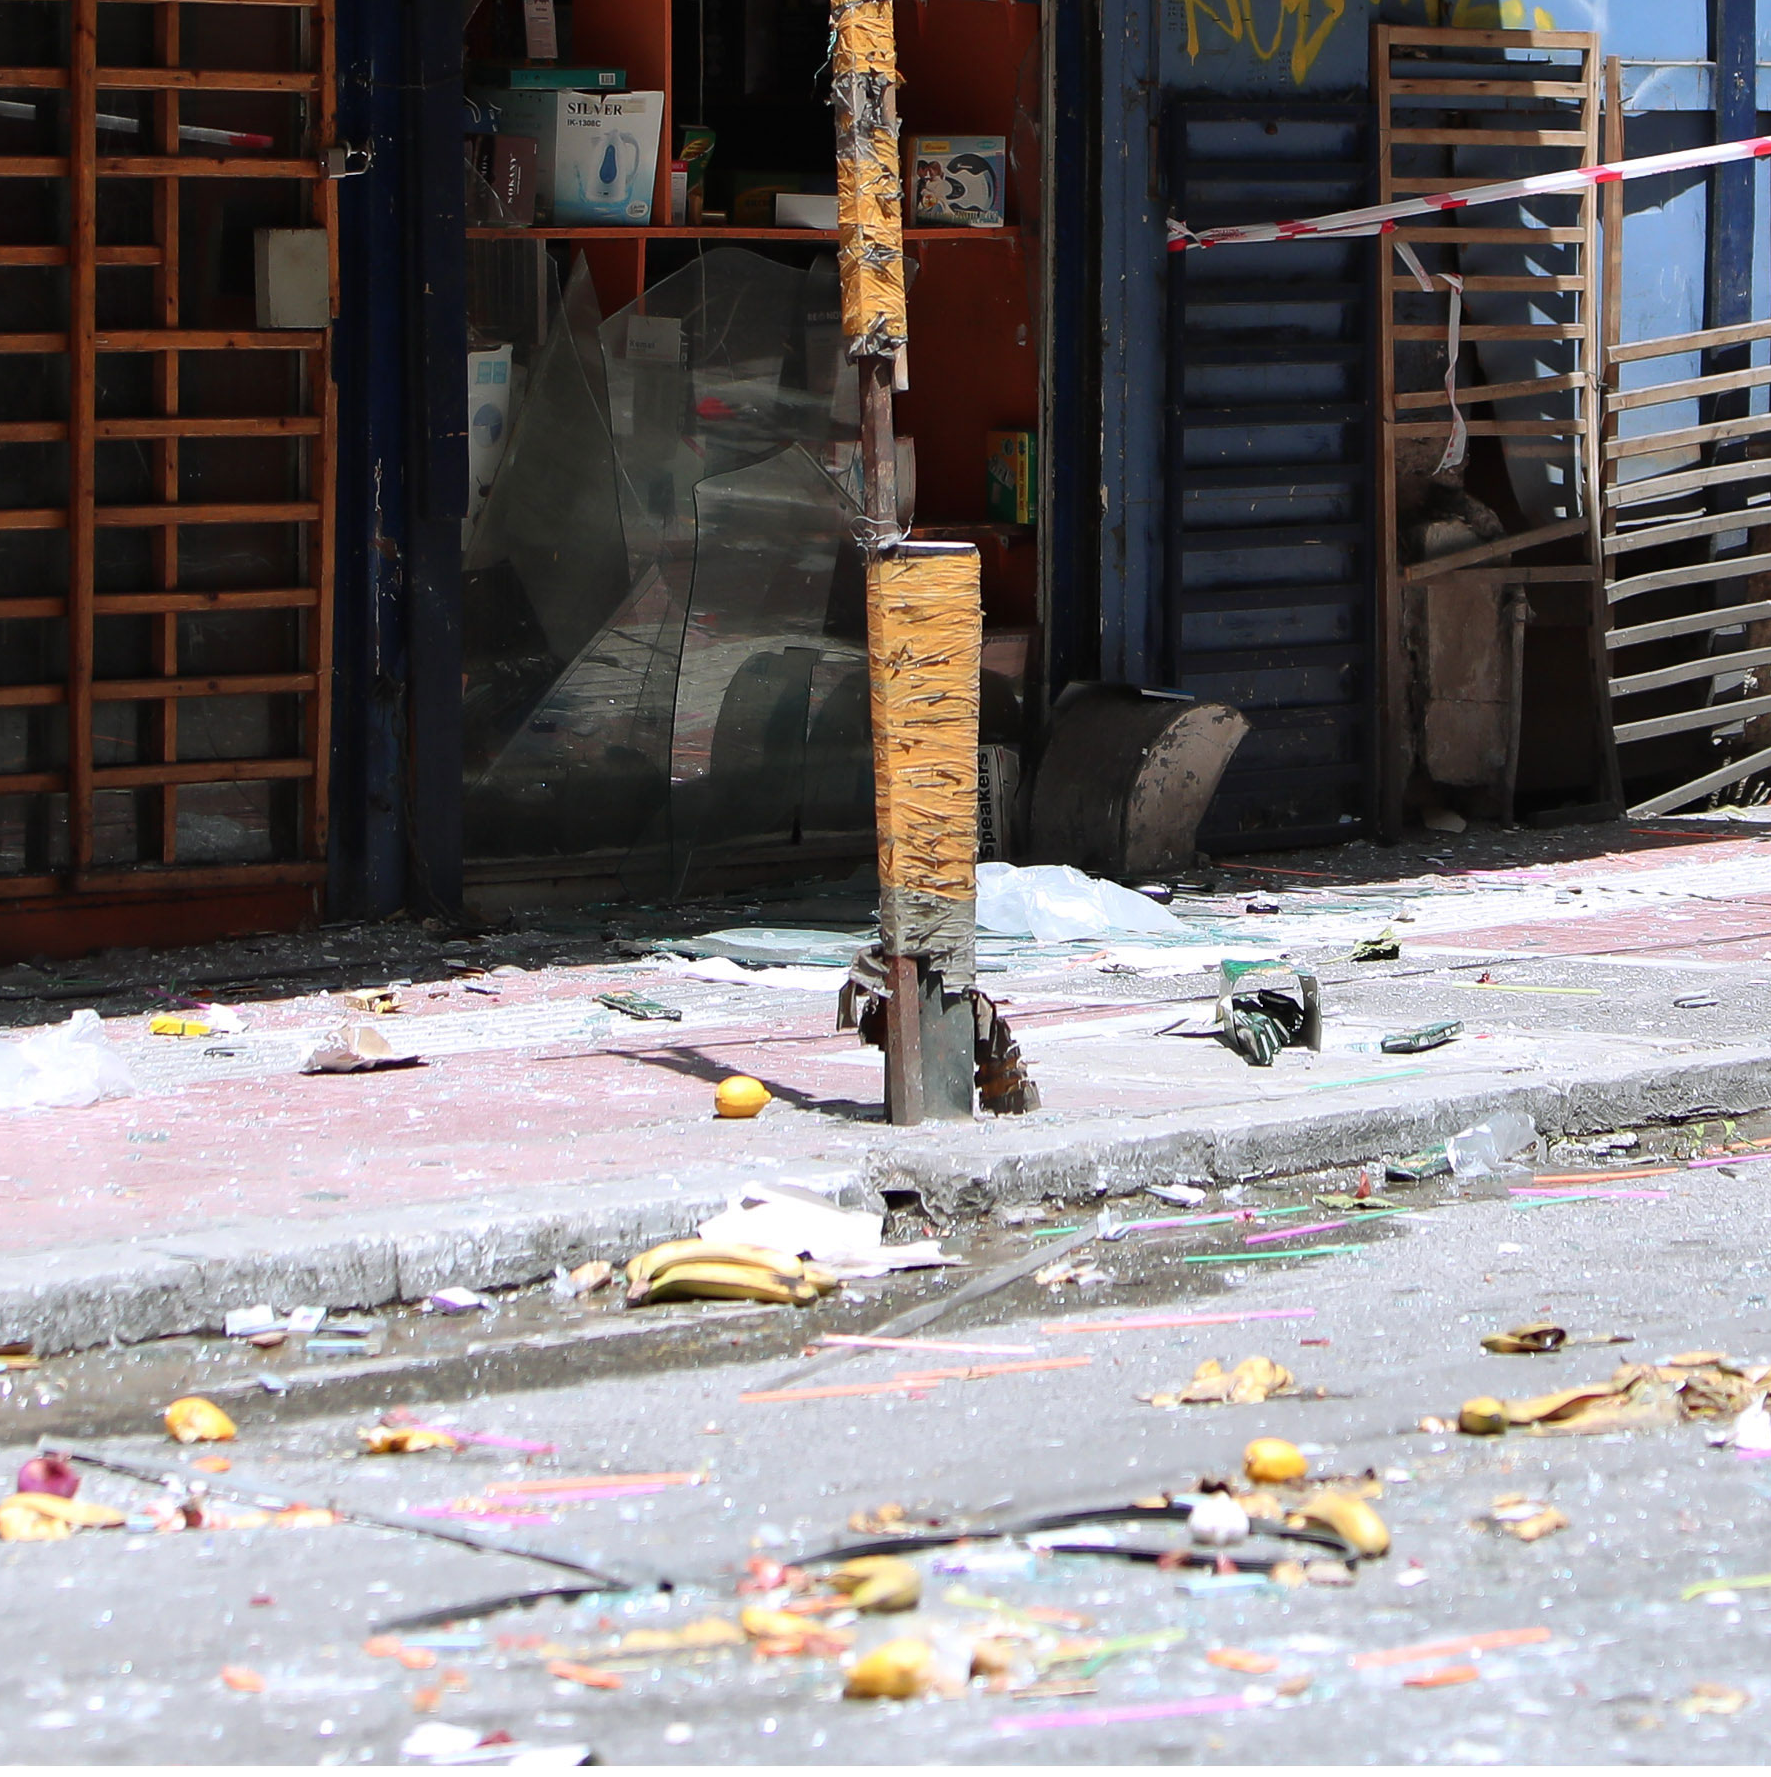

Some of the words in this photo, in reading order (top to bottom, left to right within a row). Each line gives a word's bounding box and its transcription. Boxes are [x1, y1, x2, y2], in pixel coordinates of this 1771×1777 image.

[566, 102, 623, 116] SILVER
[507, 155, 518, 204] SOKANY
[978, 752, 995, 860] Speakers
